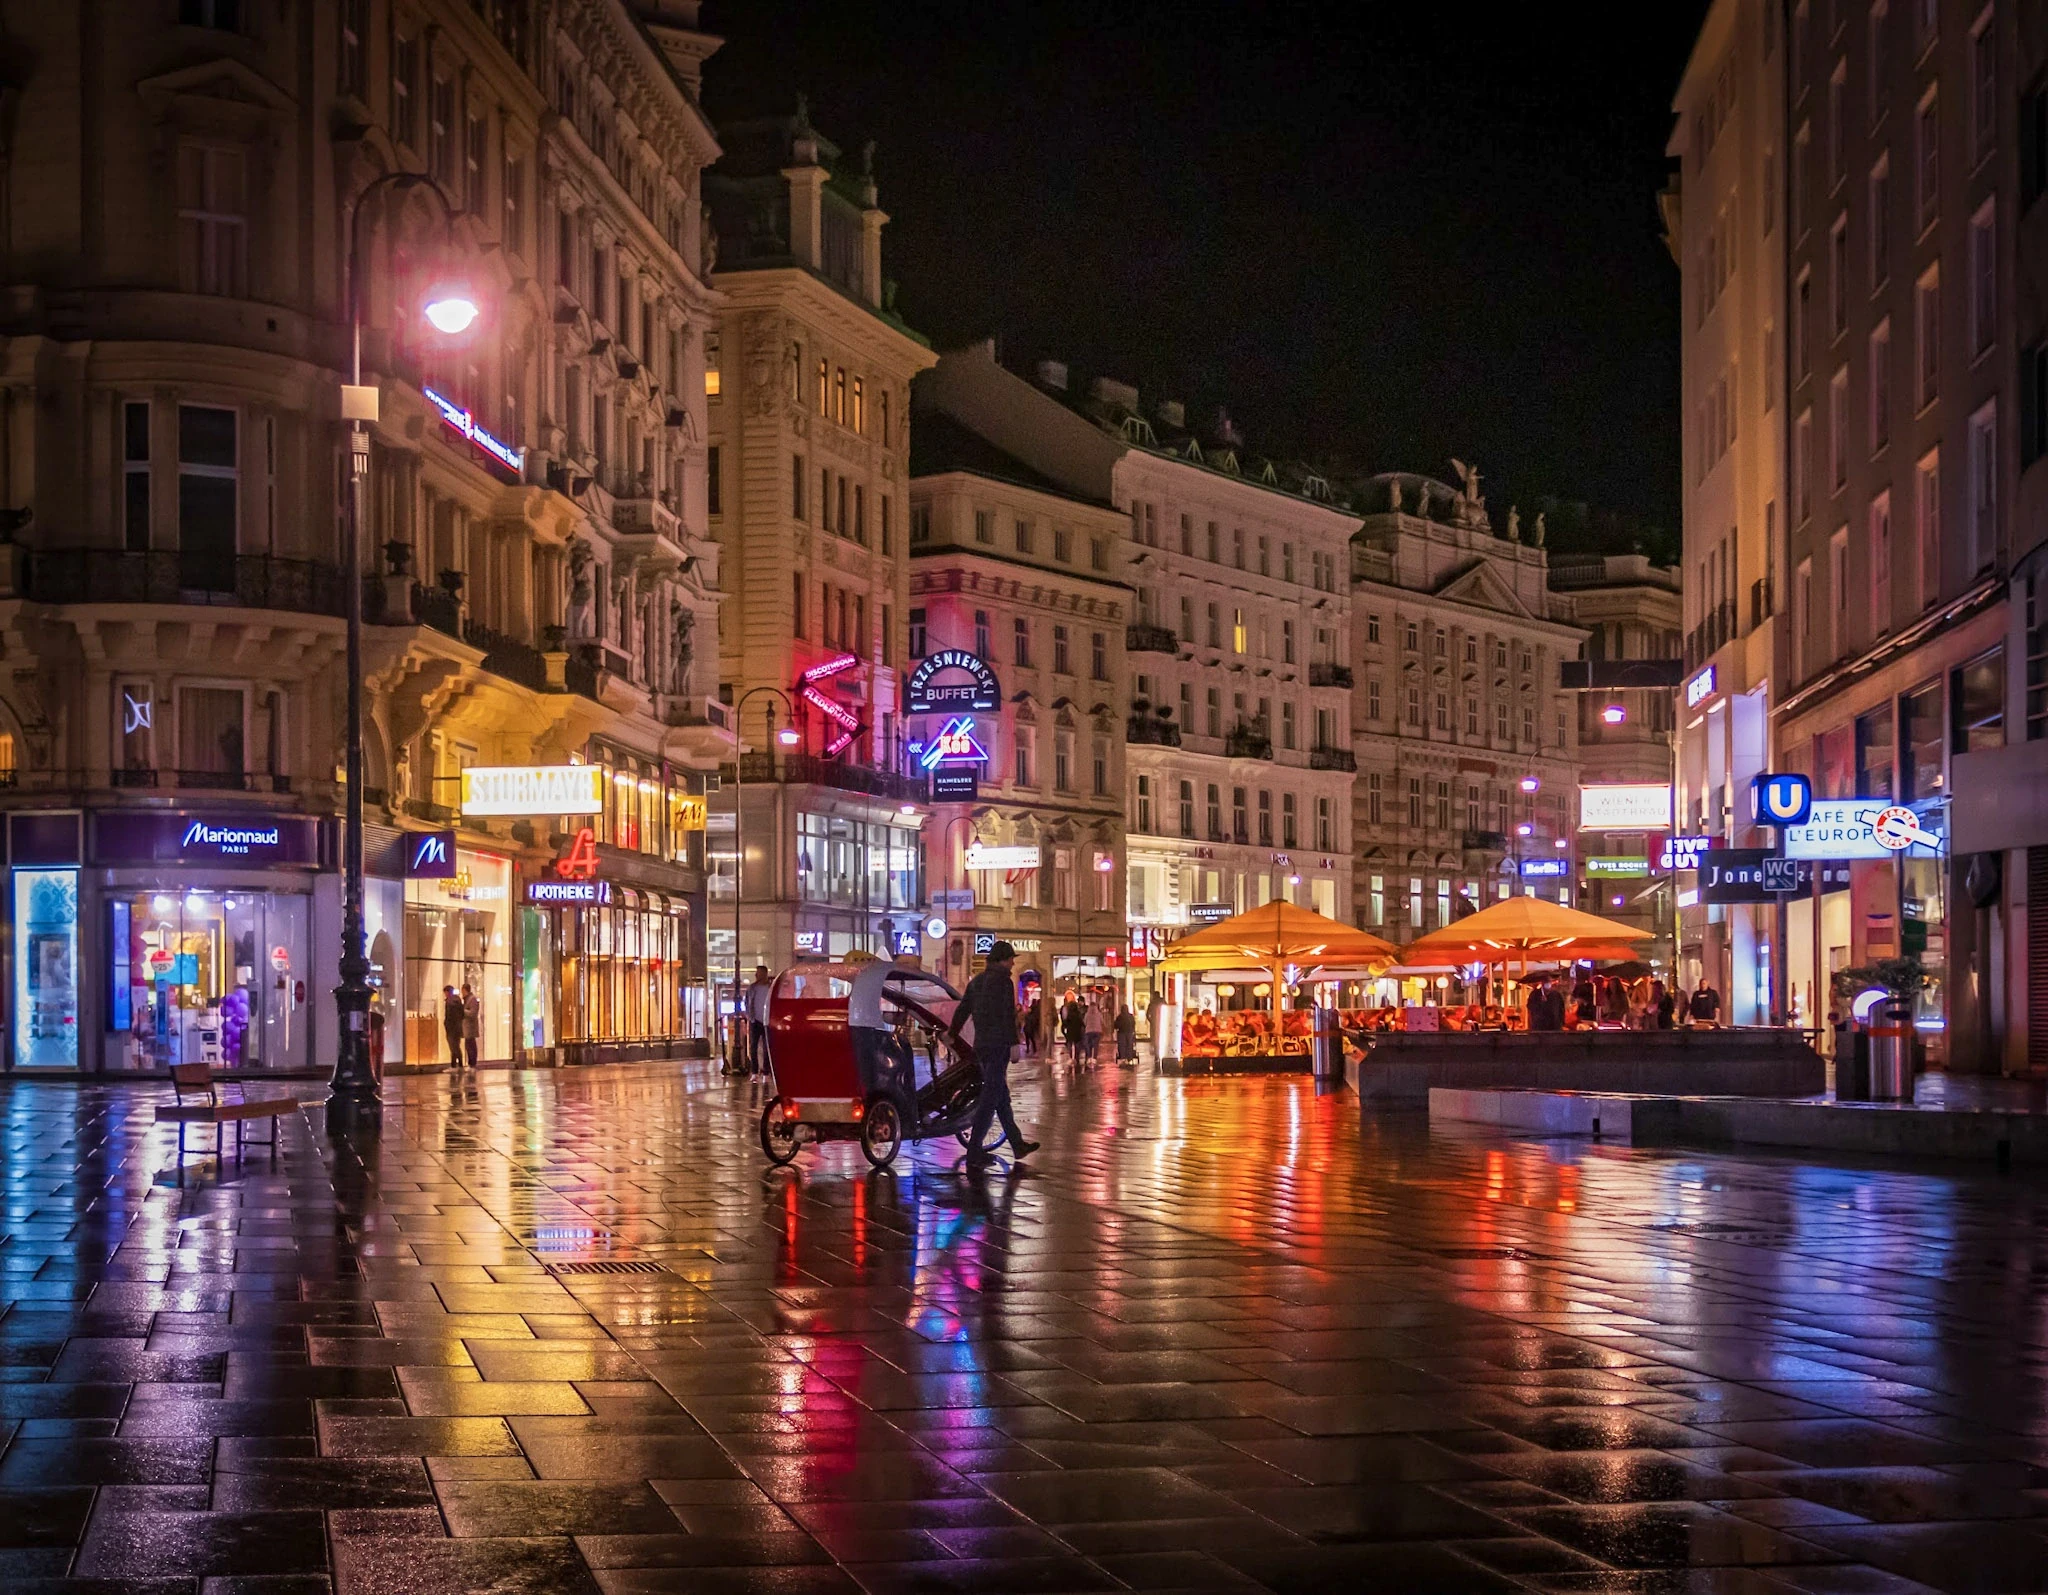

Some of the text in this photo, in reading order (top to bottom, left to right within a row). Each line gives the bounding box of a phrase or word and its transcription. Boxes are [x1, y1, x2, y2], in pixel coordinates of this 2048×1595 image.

[926, 688, 977, 700] BUFFET
[1769, 784, 1802, 818] U
[183, 823, 278, 847] Marionnaud
[1789, 828, 1873, 842] L'EUROP
[1665, 838, 1709, 853] FIVE
[1660, 854, 1699, 868] GUY
[1767, 861, 1795, 876] WC
[1709, 866, 1762, 887] Jone
[535, 885, 594, 899] APOTHEKE
